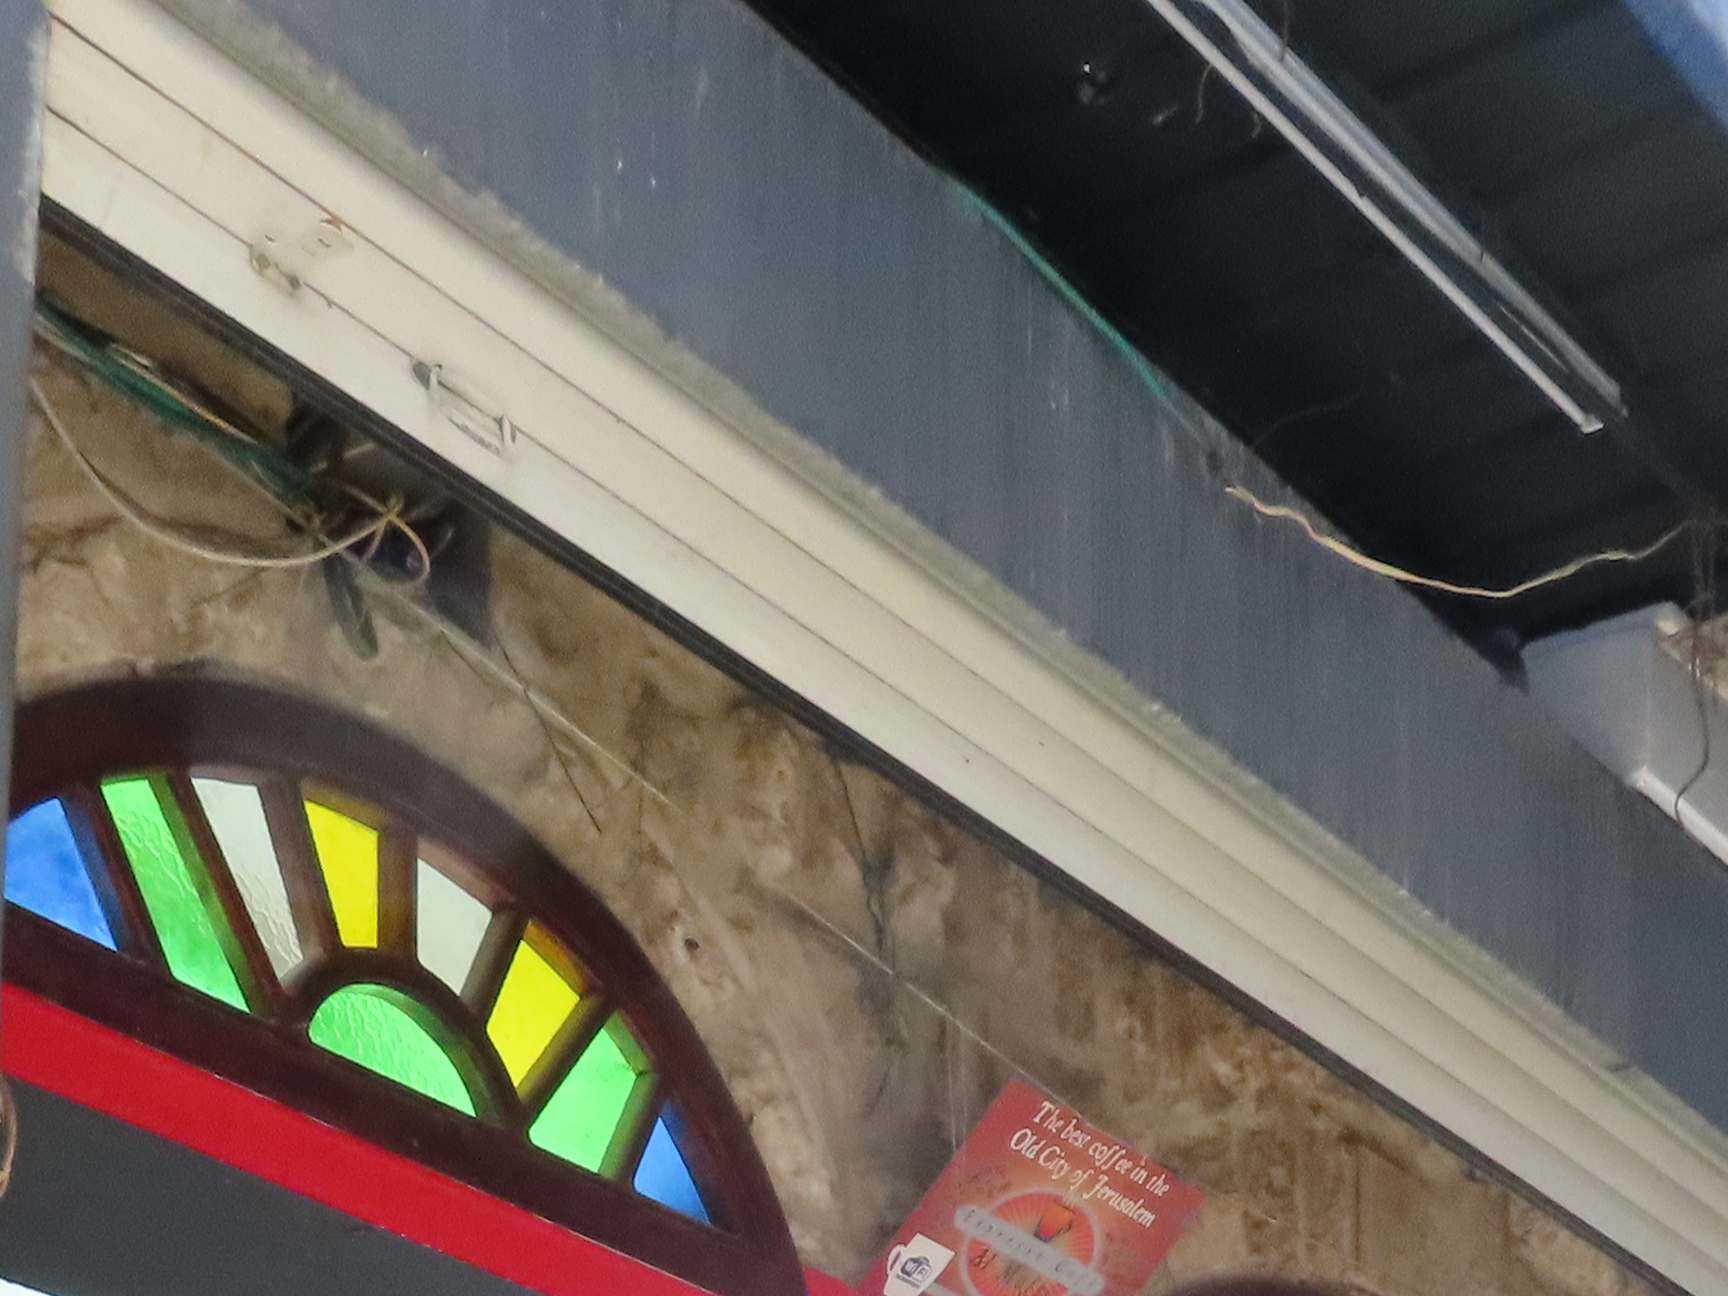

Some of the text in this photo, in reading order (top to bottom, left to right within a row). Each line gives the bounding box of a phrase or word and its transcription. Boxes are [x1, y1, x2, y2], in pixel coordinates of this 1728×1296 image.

[1010, 1127, 1157, 1228] Old City of Jerusalem
[1032, 1100, 1171, 1197] The best coffee in the
